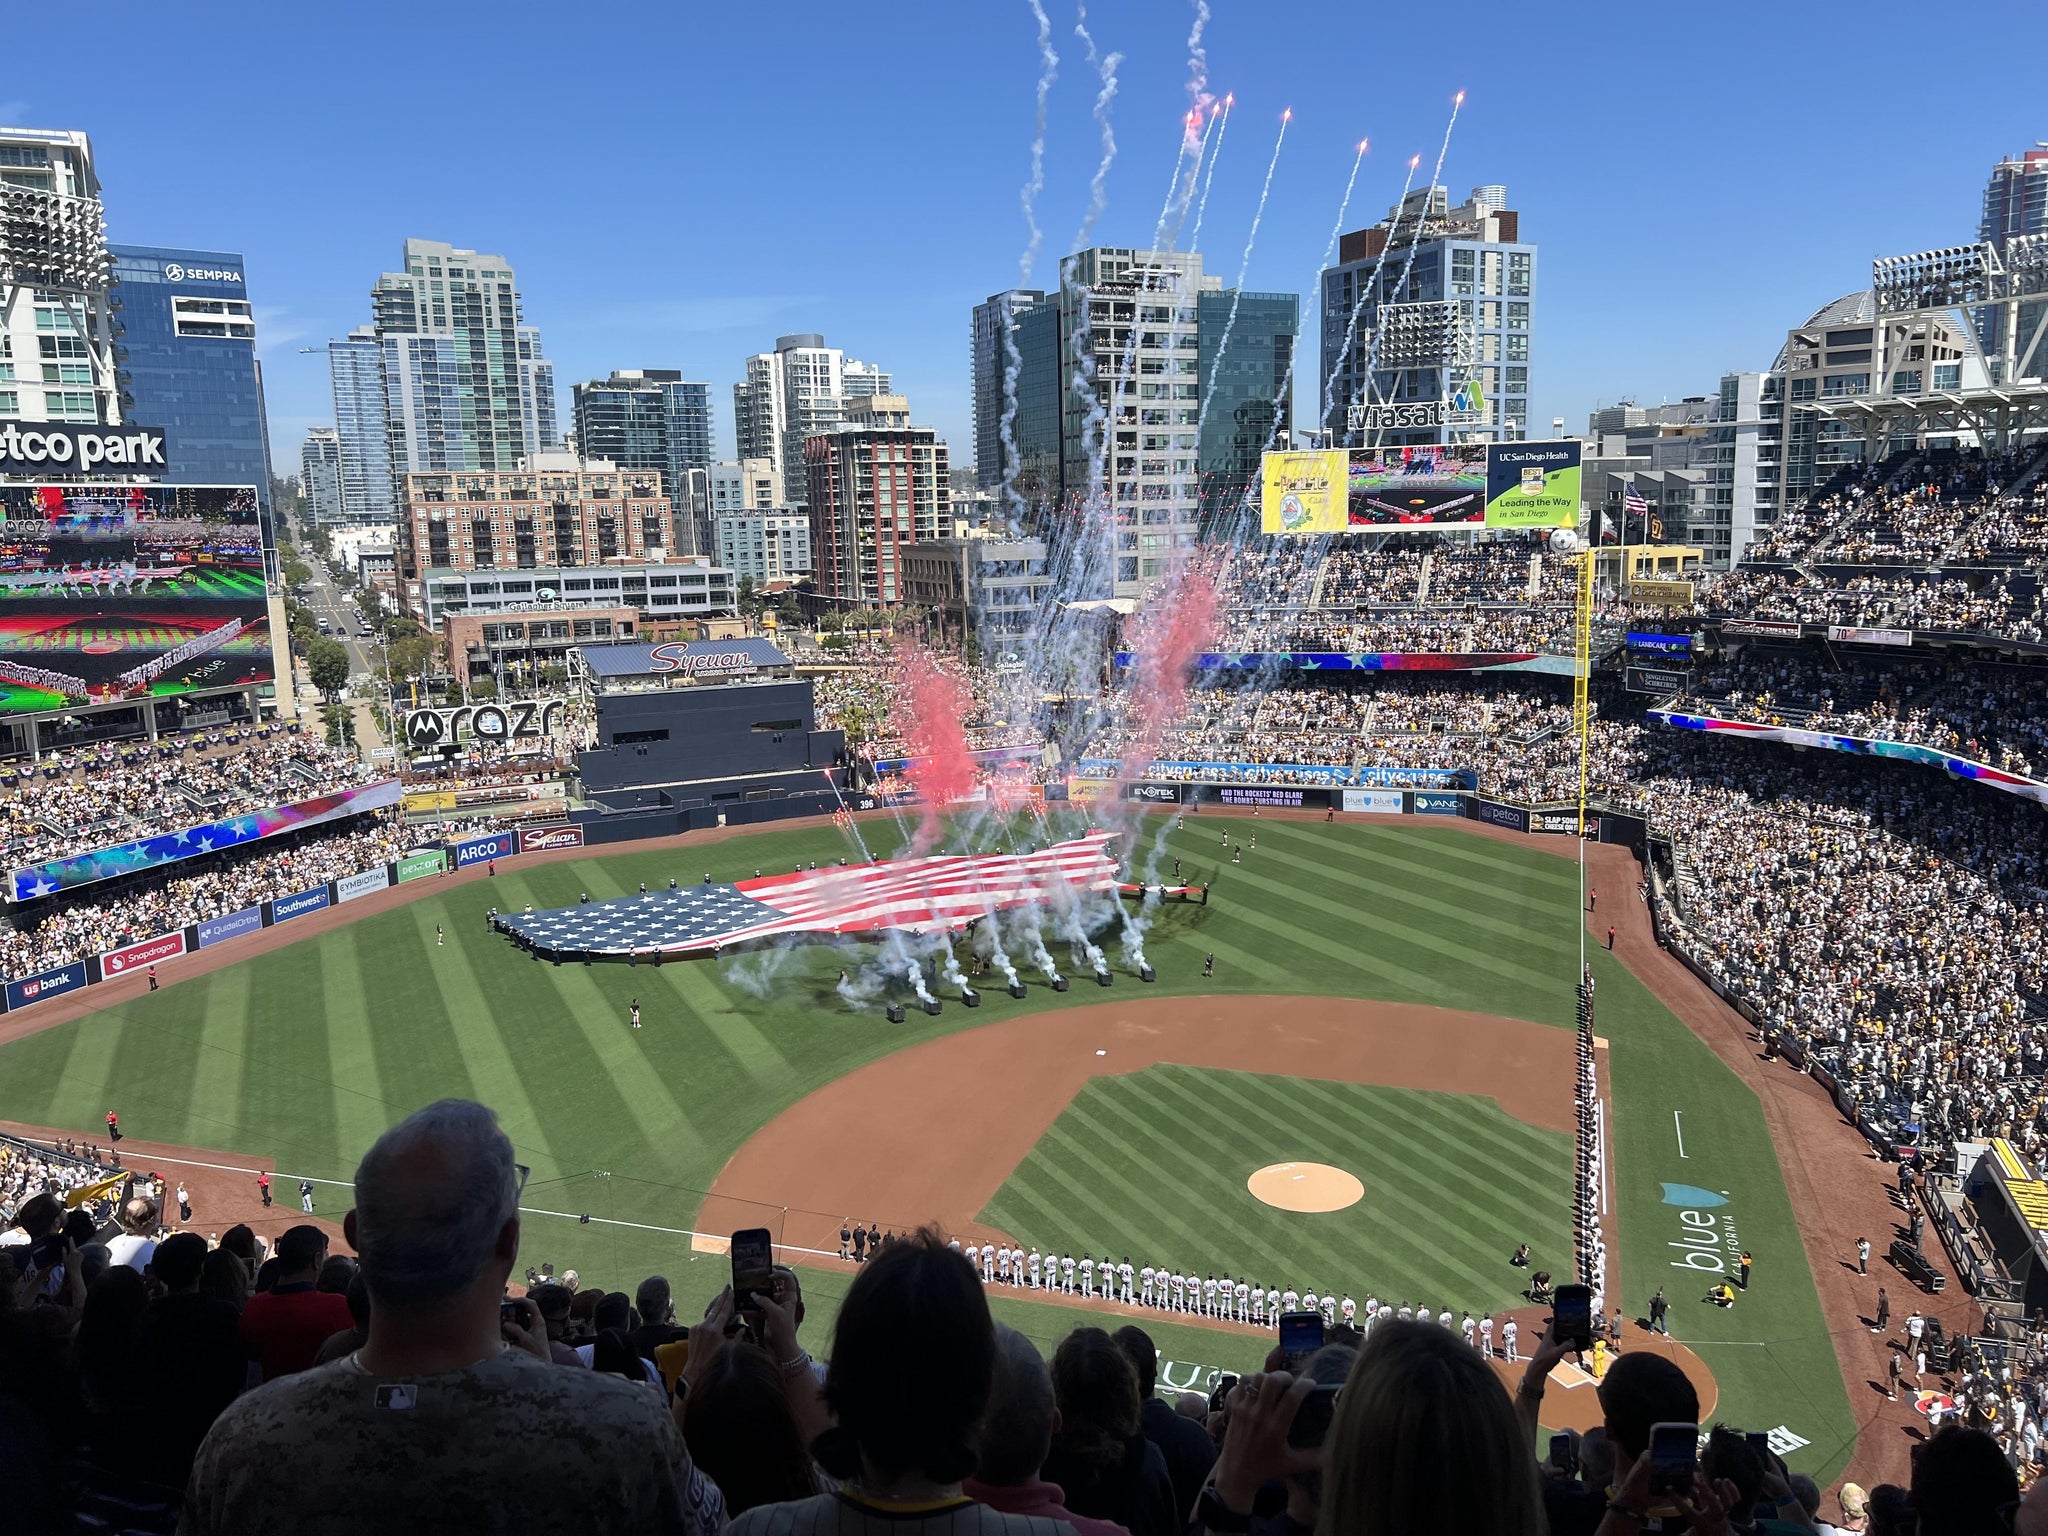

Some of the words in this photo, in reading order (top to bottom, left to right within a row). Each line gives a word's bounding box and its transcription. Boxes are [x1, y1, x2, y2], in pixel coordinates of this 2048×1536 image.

[187, 268, 242, 282] SEMPRA
[1354, 401, 1444, 429] Viasat
[0, 424, 73, 463] tco
[78, 432, 165, 471] park
[1500, 453, 1511, 462] UC
[1512, 453, 1525, 461] San
[1525, 452, 1546, 462] Diego
[1545, 451, 1569, 460] Health
[1500, 499, 1535, 508] Leading
[1536, 498, 1551, 506] the
[1552, 498, 1571, 507] Way
[1509, 510, 1525, 518] San
[1527, 510, 1549, 518] Diego
[508, 600, 553, 612] Gallagher
[553, 600, 585, 610] Square
[1638, 640, 1667, 650] LANDCARE
[650, 641, 753, 678] Sycuan
[1644, 672, 1678, 682] SINGLETON
[1644, 680, 1678, 689] SCHREIBER
[450, 701, 565, 742] razr
[860, 799, 874, 810] 396
[1345, 795, 1363, 804] blue
[1373, 797, 1393, 805] blue
[1493, 808, 1520, 823] petco
[1544, 816, 1561, 824] SLAP
[524, 830, 577, 849] Sycuan
[460, 842, 497, 862] ARCO
[276, 896, 321, 916] Southwest
[213, 914, 259, 936] QuidelOrtho
[128, 942, 177, 963] Snapdragon
[24, 983, 40, 996] us
[40, 972, 71, 991] bank
[1667, 1210, 1726, 1274] blue
[1721, 1215, 1743, 1277] CALIFORNIA
